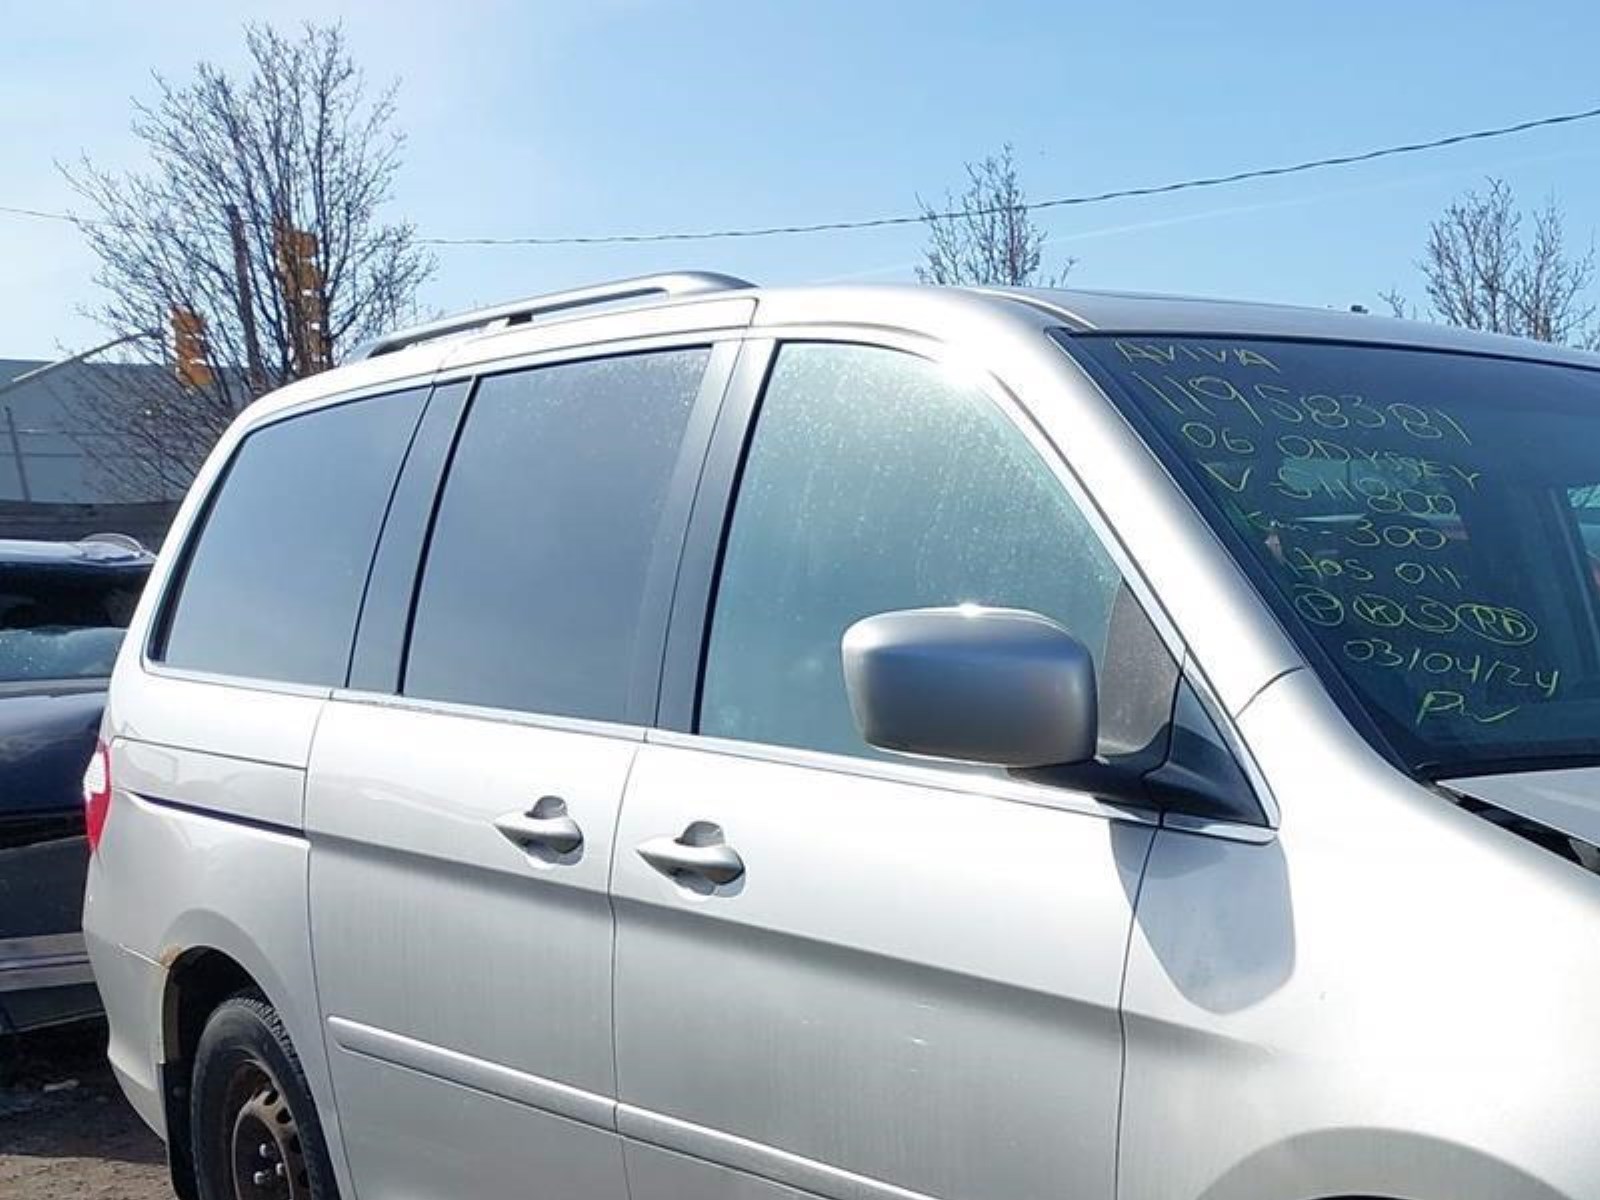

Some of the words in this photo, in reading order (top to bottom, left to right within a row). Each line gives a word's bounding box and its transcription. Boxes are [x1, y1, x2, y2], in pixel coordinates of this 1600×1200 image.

[1114, 338, 1281, 373] AVIVA
[1131, 370, 1472, 446] 11958381
[1180, 422, 1254, 453] 06
[1344, 518, 1448, 551] 300
[1343, 639, 1560, 698] 03/04/24
